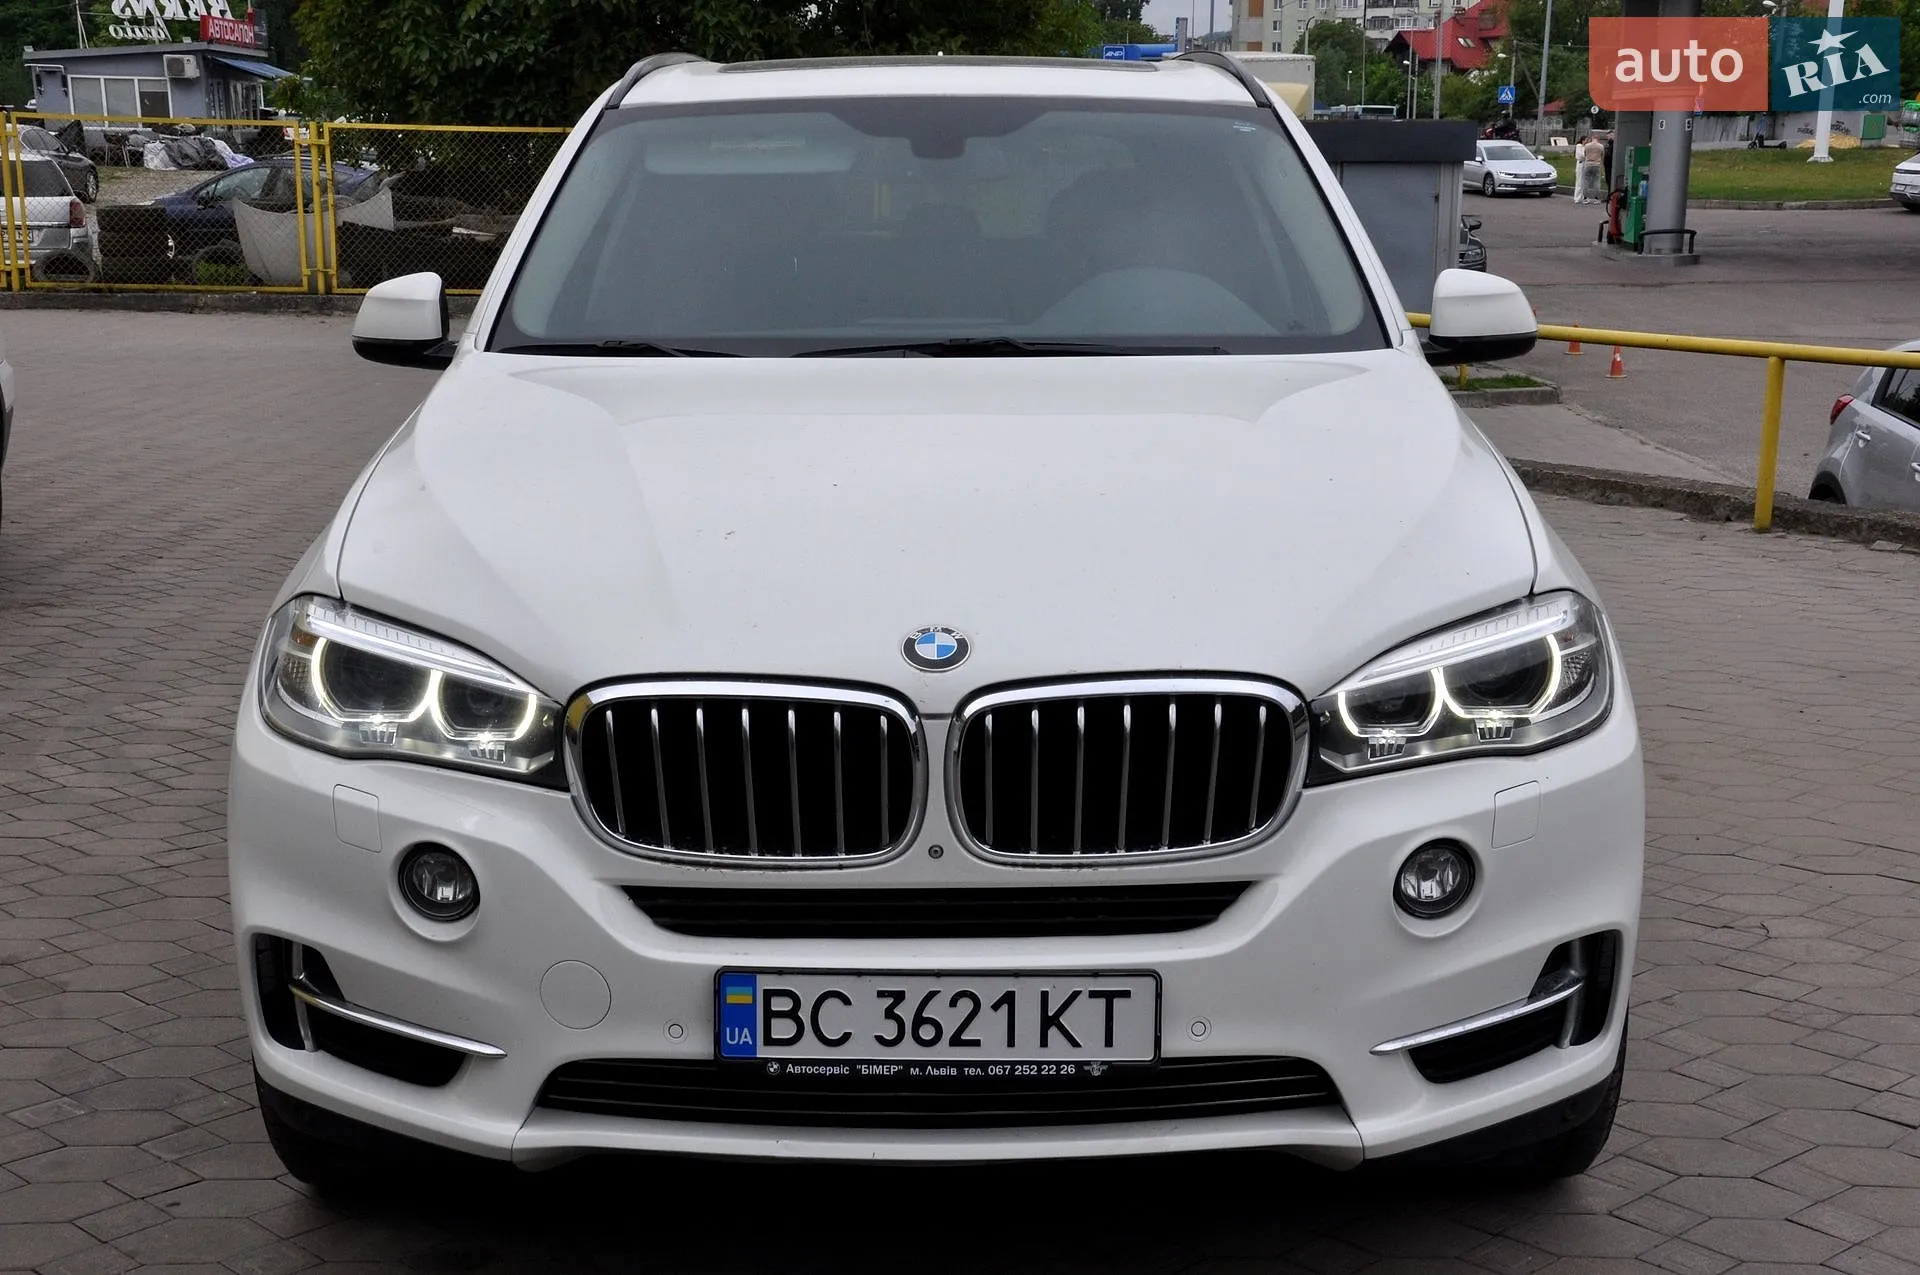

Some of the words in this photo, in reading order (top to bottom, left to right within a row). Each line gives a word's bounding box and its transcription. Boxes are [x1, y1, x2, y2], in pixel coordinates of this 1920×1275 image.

[208, 17, 255, 44] АВТОСАЛОН
[762, 988, 853, 1048] BC
[873, 989, 1016, 1048] 3621
[1039, 989, 1132, 1048] KT
[726, 1027, 752, 1045] UA
[786, 1063, 850, 1076] Автосервіс
[856, 1064, 903, 1075] "БІМЕР"
[910, 1067, 923, 1076] м.
[925, 1065, 957, 1076] Львів
[963, 1067, 985, 1076] тел.
[988, 1065, 1011, 1075] 067
[1014, 1065, 1038, 1075] 252
[1041, 1065, 1056, 1075] 22
[1060, 1064, 1076, 1075] 26
